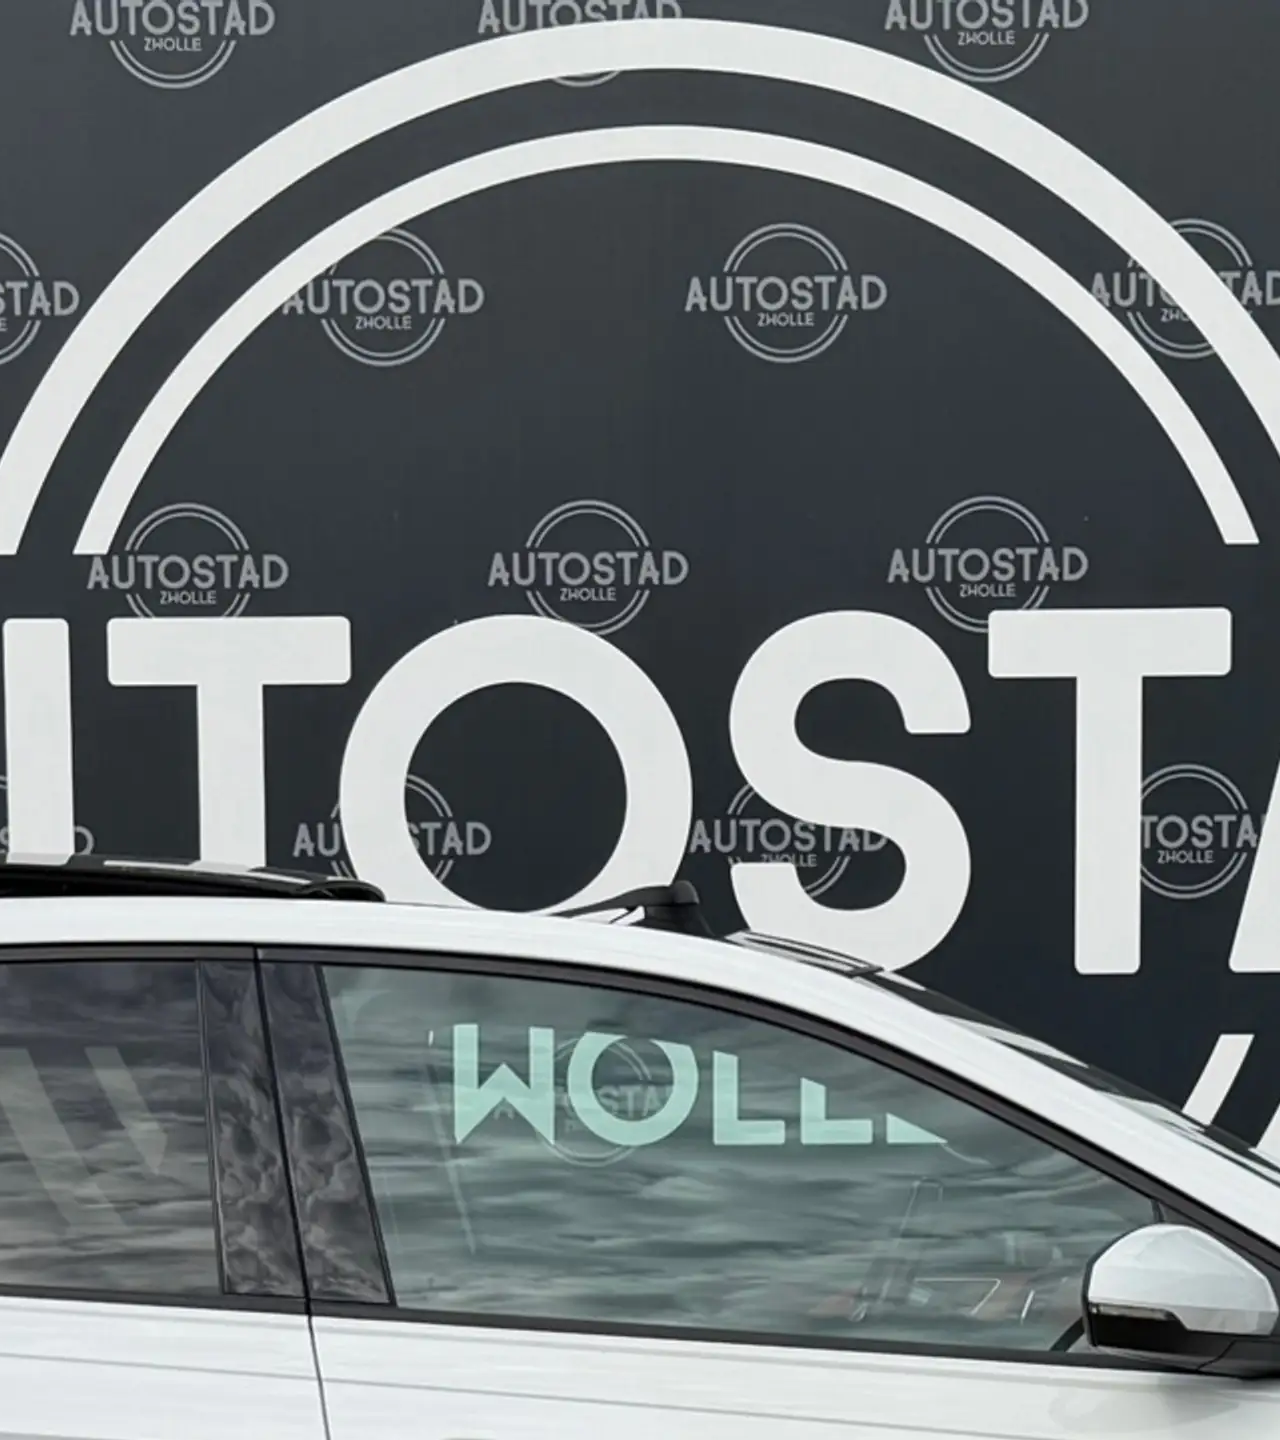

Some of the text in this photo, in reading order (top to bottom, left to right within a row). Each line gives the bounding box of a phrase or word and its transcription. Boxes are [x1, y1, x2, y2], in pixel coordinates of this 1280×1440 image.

[68, 0, 276, 35] AUTOSTAD
[684, 276, 888, 311] AUTOSTAD
[86, 554, 290, 589] AUTOSTAD
[486, 551, 690, 586] AUTOSTAD
[886, 547, 1090, 582] AUTOSTAD
